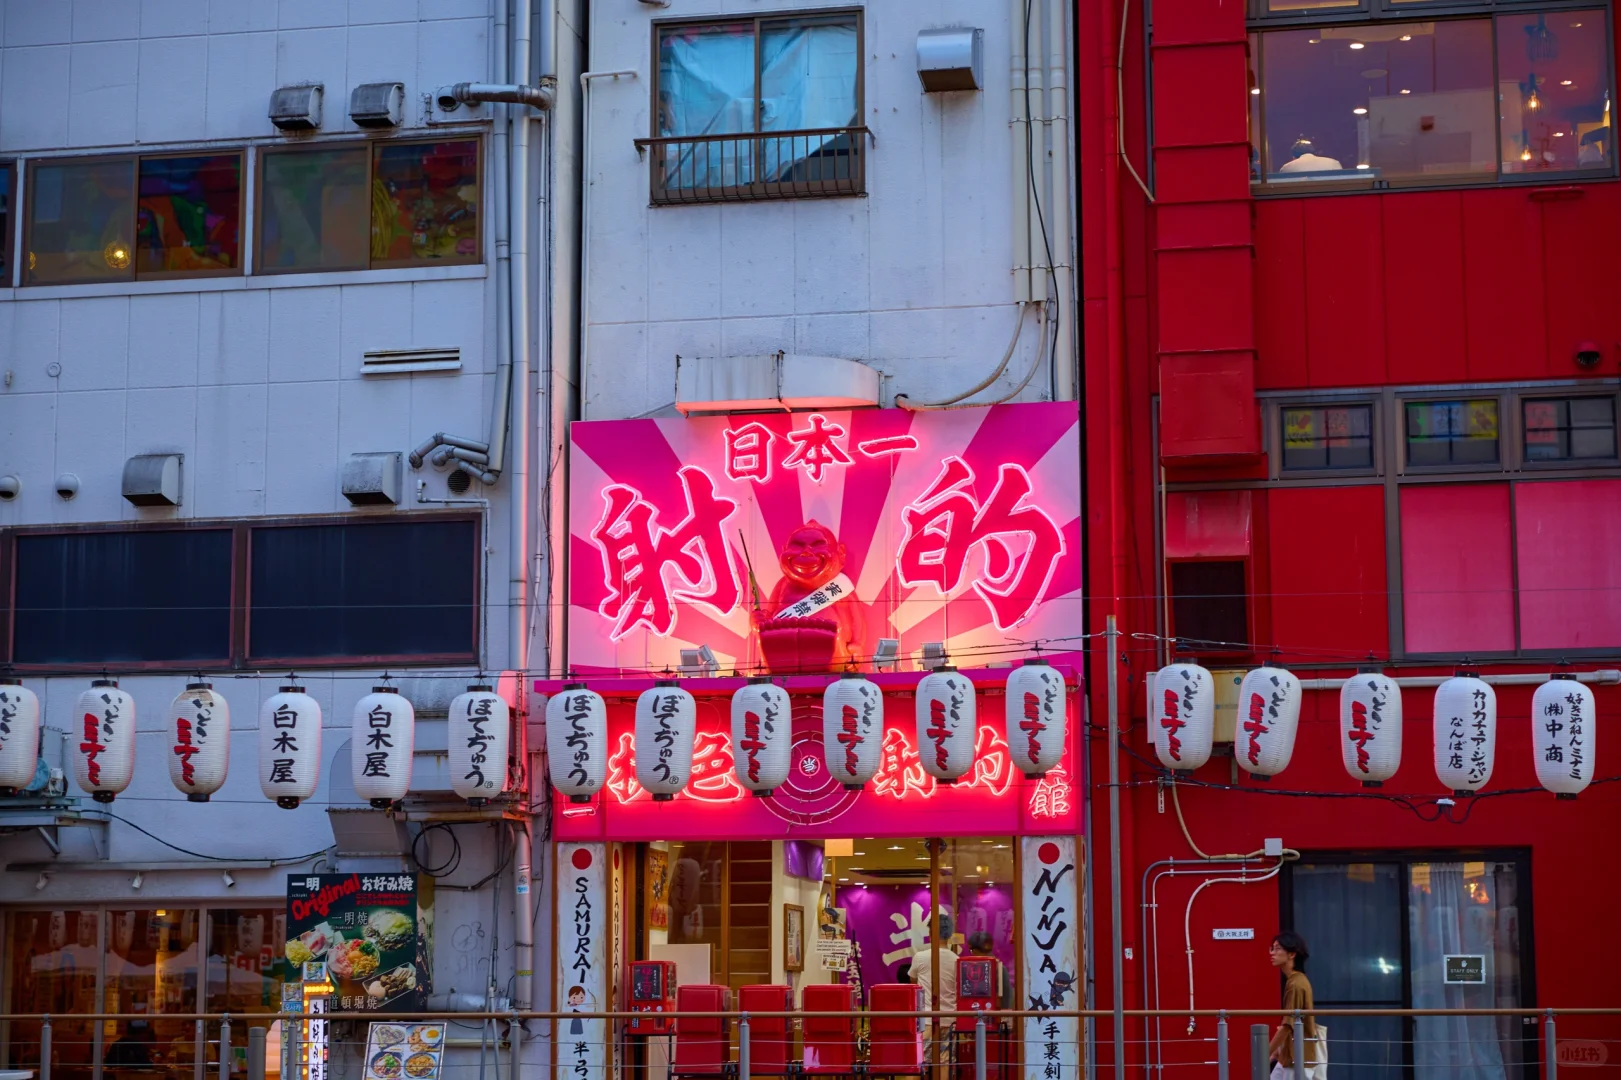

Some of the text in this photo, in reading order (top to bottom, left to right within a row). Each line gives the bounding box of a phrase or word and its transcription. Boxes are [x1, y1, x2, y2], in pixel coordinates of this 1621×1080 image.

[723, 414, 919, 483] 日本一
[80, 713, 106, 785] ミナミ
[174, 717, 200, 786] ミナミ
[269, 704, 299, 783] 白木屋
[362, 704, 394, 778] 白木屋
[740, 711, 767, 783] ミナミ
[837, 704, 864, 776] ミナミ
[926, 698, 953, 771] ミナミ
[1019, 692, 1046, 764] ミナミ
[1160, 689, 1187, 761] ミナミ
[1243, 692, 1269, 766] ミナミ
[1348, 701, 1375, 773] ミナミ
[1448, 717, 1468, 769] なんば店
[1468, 688, 1487, 784] カリカチュア・ジャパン
[1564, 692, 1584, 780] 好きやねんミナミ
[291, 877, 320, 890] 一明
[291, 872, 360, 920] Original
[331, 911, 368, 925] 一明焼
[362, 876, 413, 891] お好み焼
[1031, 864, 1074, 973] NINJA
[572, 876, 592, 984] SAMURAI
[573, 1041, 590, 1080] 半弓
[1042, 1022, 1061, 1080] 手裏剣
